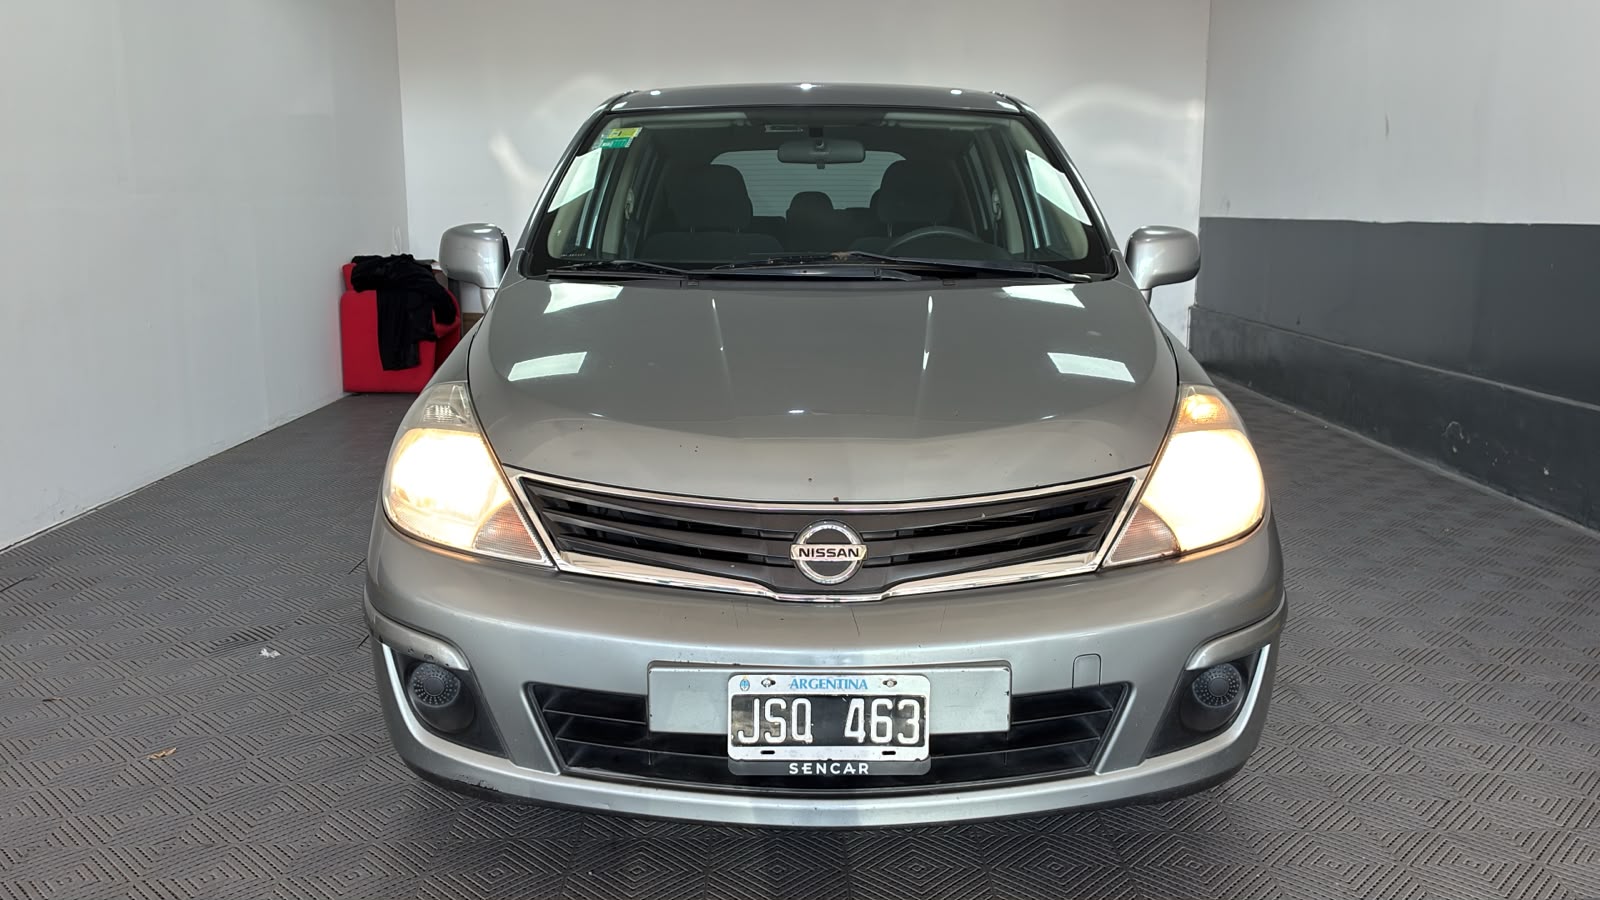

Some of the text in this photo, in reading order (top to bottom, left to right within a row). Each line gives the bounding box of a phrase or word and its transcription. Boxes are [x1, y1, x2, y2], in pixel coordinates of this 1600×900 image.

[798, 547, 859, 558] NISSAN
[789, 678, 868, 690] ARGENTINA
[737, 697, 921, 745] JSQ 463
[789, 762, 869, 775] SENCAR
